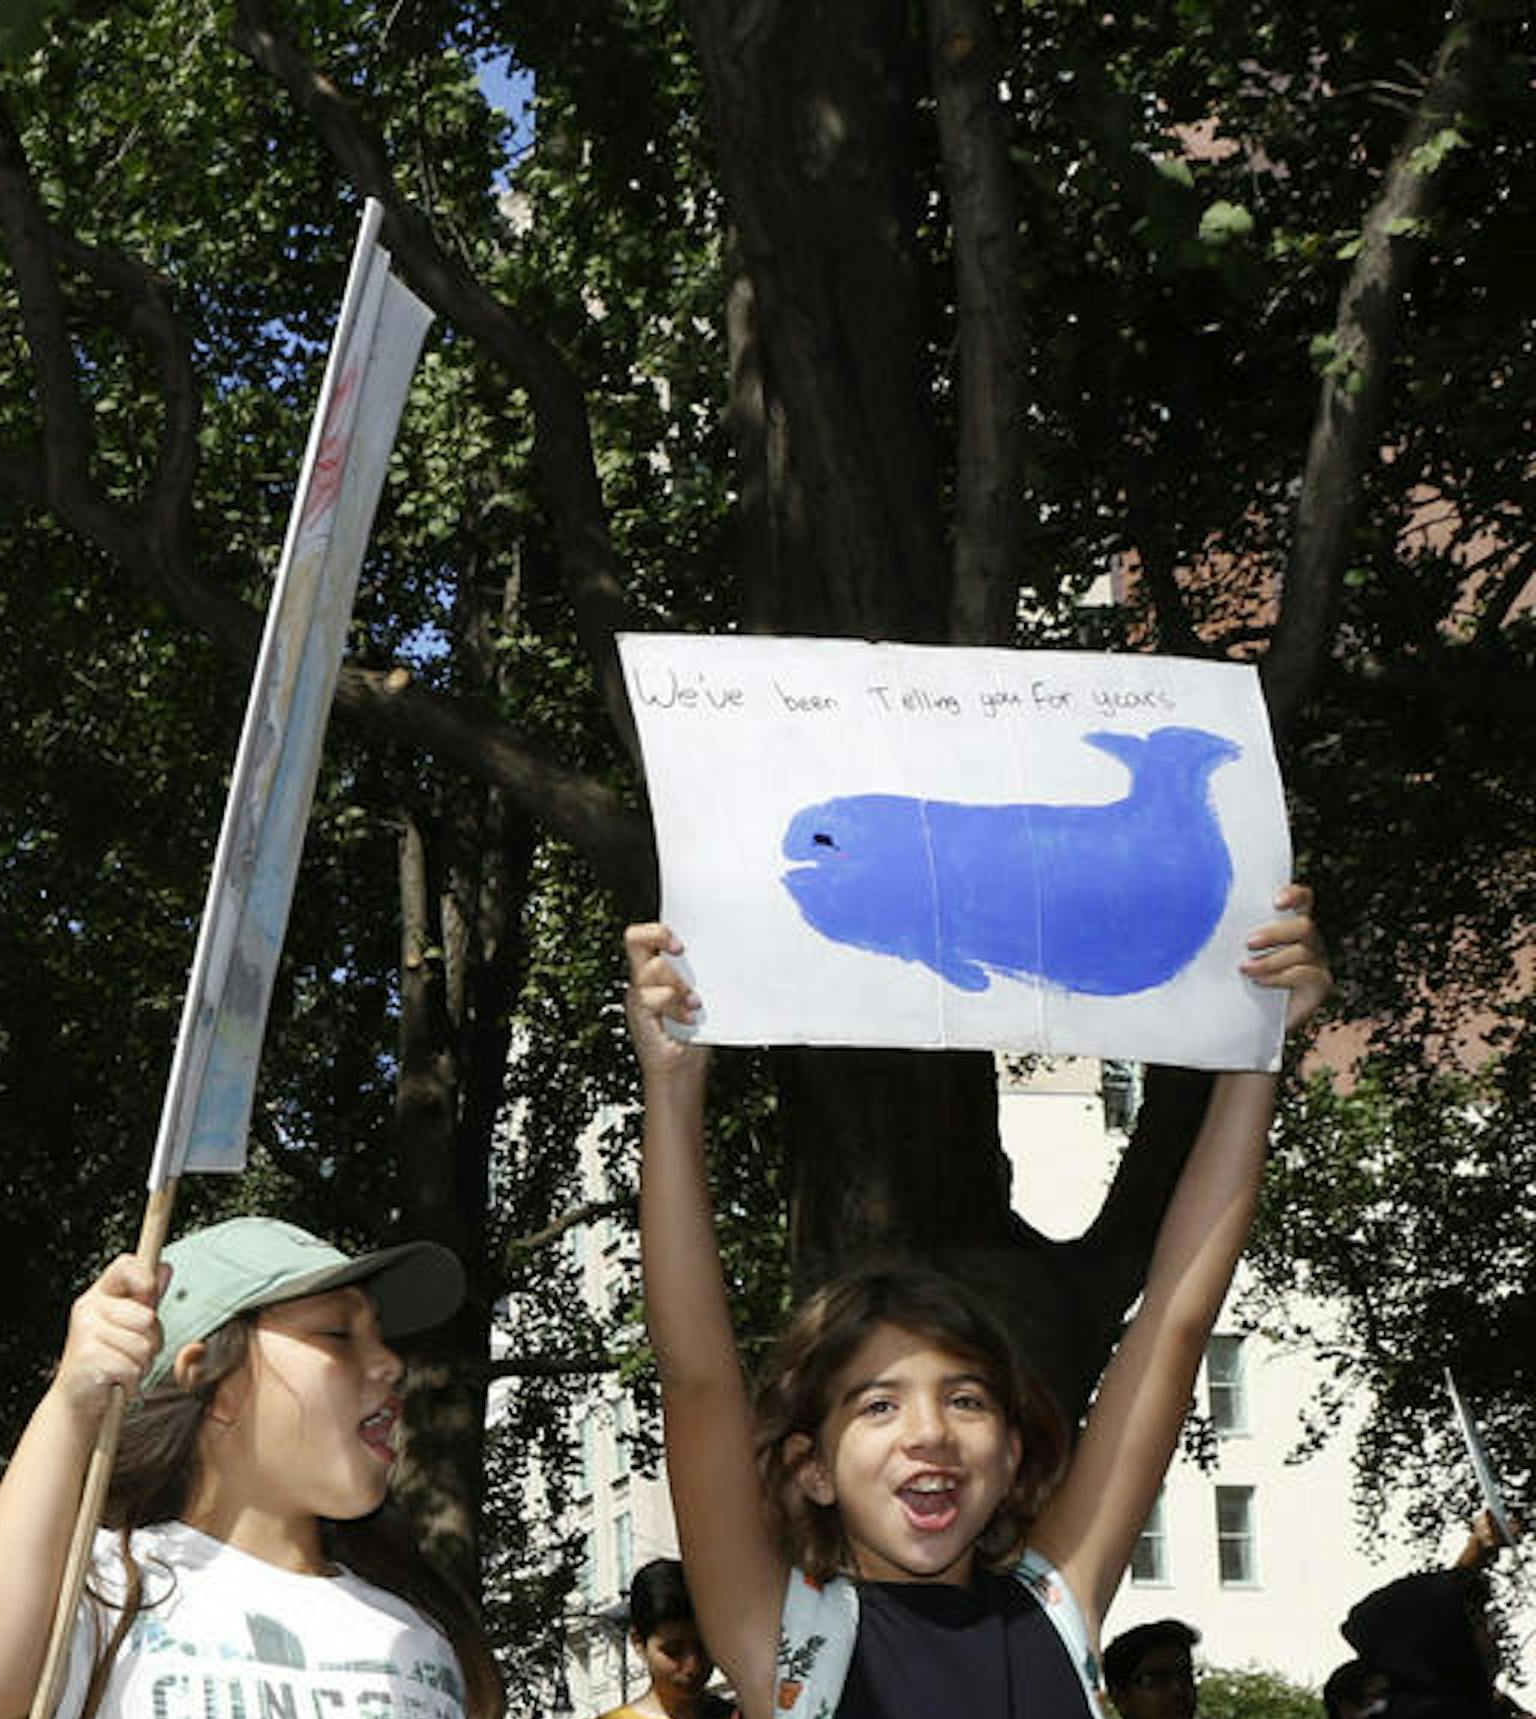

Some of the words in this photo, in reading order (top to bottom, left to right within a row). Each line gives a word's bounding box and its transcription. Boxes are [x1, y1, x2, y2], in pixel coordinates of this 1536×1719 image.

[633, 667, 745, 708] We've
[773, 677, 838, 711] been
[979, 687, 1021, 718] you
